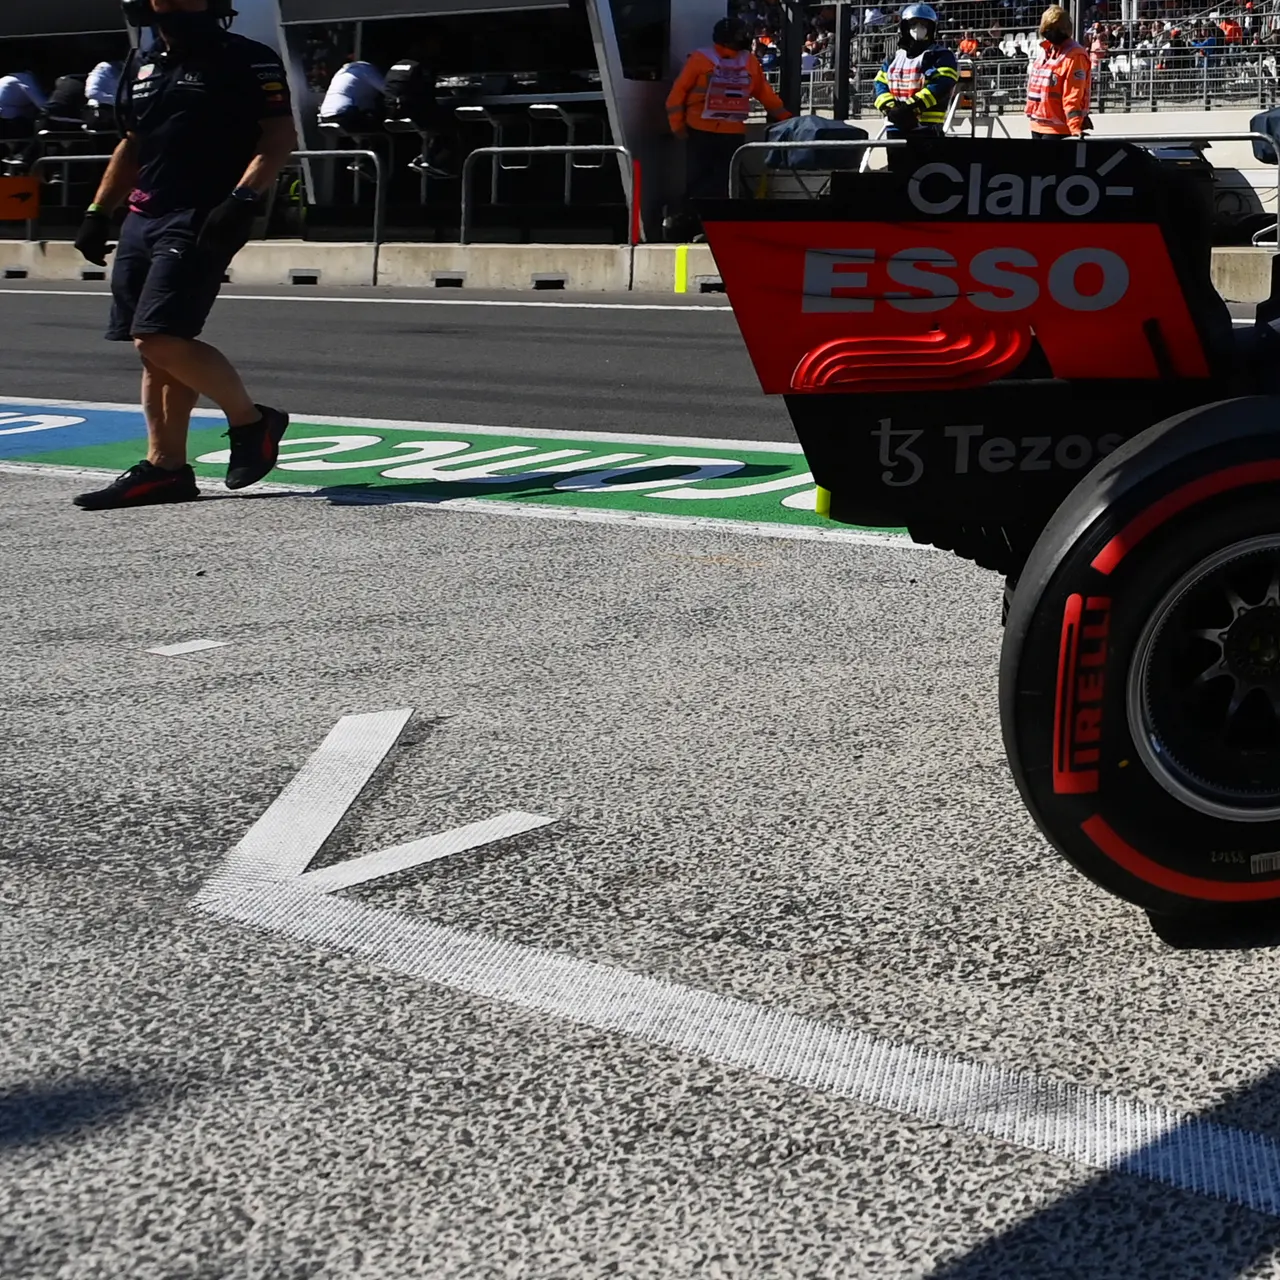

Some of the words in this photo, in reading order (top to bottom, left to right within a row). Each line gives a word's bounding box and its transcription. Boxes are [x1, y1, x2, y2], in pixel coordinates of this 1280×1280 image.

[908, 162, 1101, 216] Claro
[802, 246, 1131, 314] ESSO
[1053, 592, 1114, 794] PIRELLI
